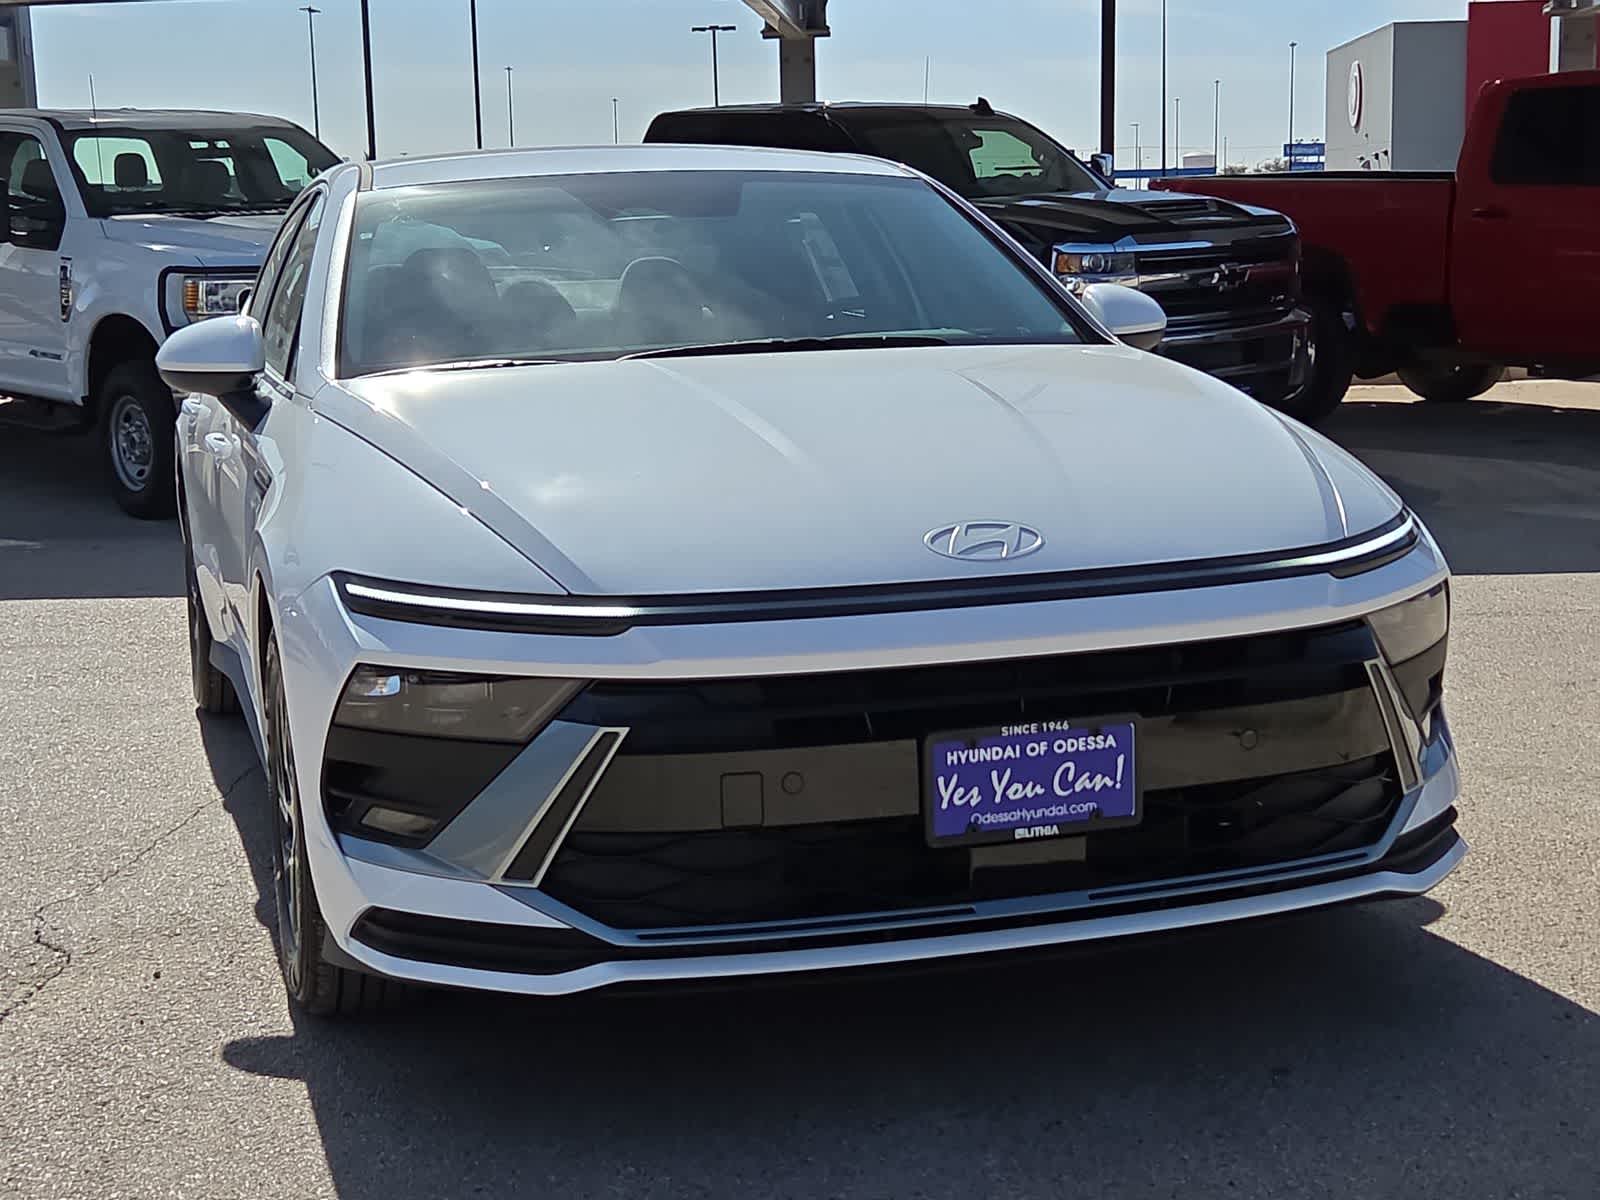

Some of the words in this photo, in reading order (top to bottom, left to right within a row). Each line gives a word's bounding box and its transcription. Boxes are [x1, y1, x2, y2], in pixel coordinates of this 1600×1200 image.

[1001, 723, 1038, 737] SINCE
[1042, 720, 1069, 732] 1946
[946, 744, 1020, 766] HYUNDAI
[1026, 741, 1048, 757] OF
[1053, 734, 1117, 754] ODESSA
[937, 773, 981, 810] Yes
[991, 767, 1045, 803] You
[1053, 753, 1125, 797] Can!
[970, 801, 1098, 825] OdessaHyundai.com
